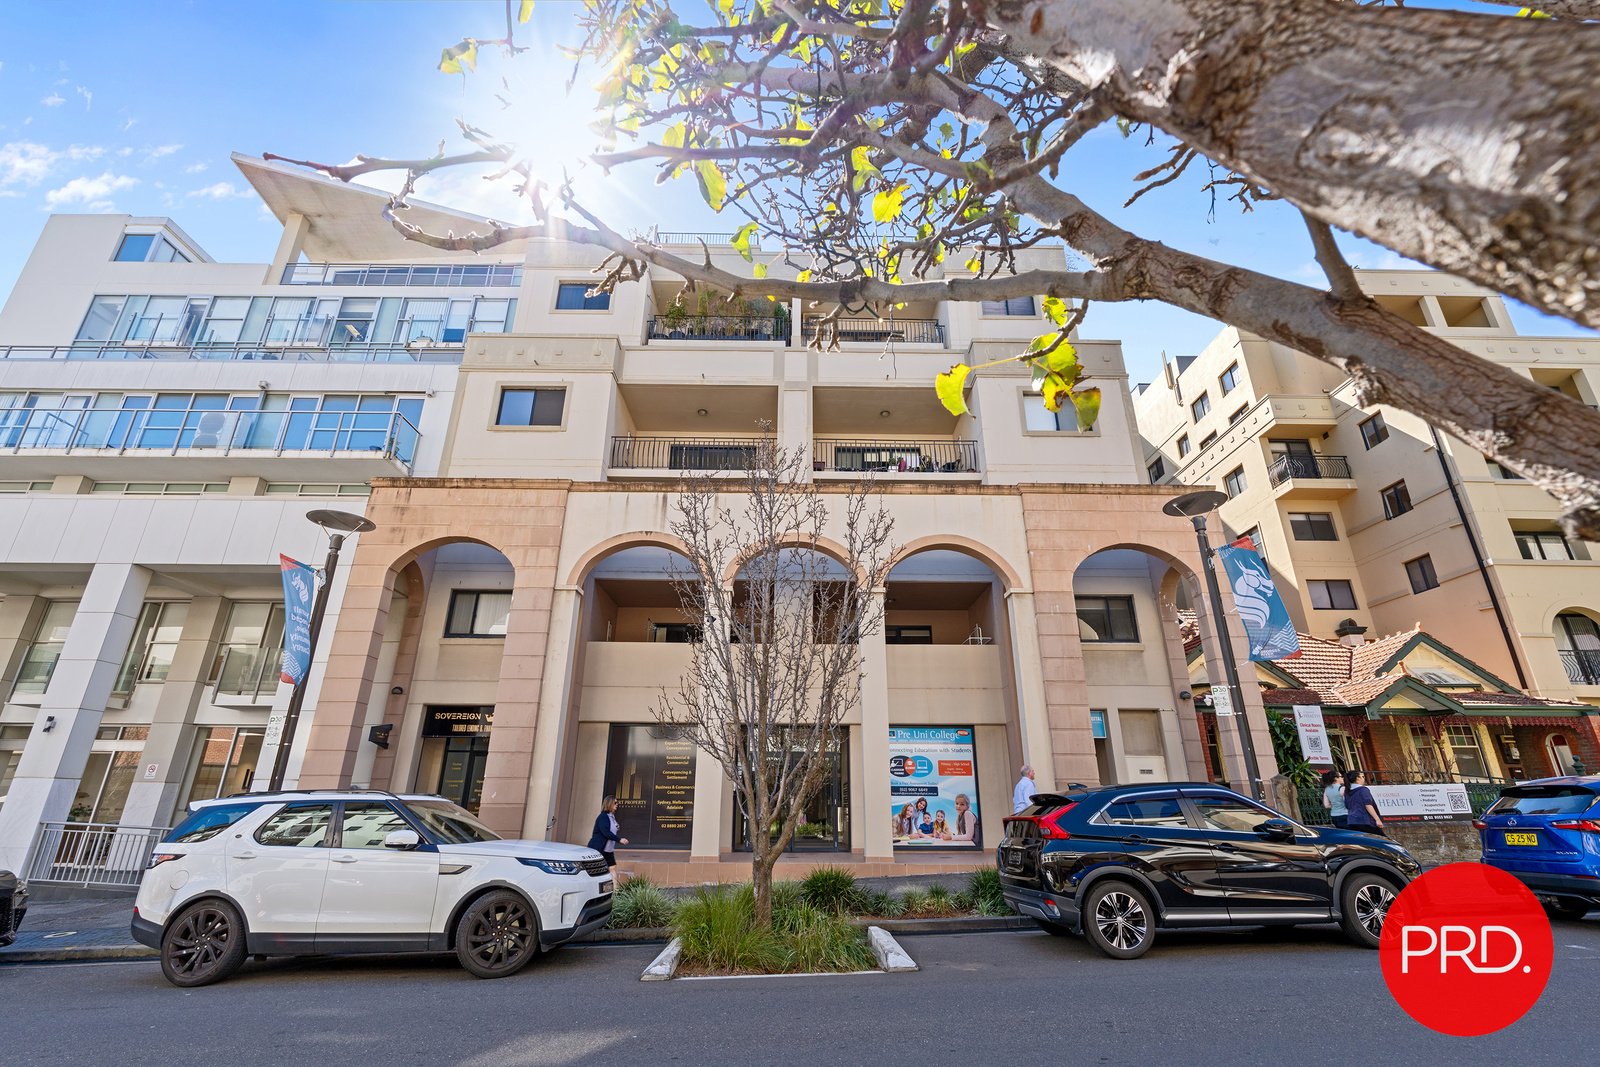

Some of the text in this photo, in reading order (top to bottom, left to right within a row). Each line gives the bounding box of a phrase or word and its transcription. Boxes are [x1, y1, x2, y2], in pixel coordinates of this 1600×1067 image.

[435, 712, 481, 720] SOVEREIGN
[897, 730, 911, 739] Pre
[913, 730, 928, 739] Uni
[929, 730, 960, 741] College
[1378, 798, 1414, 807] HEALTH
